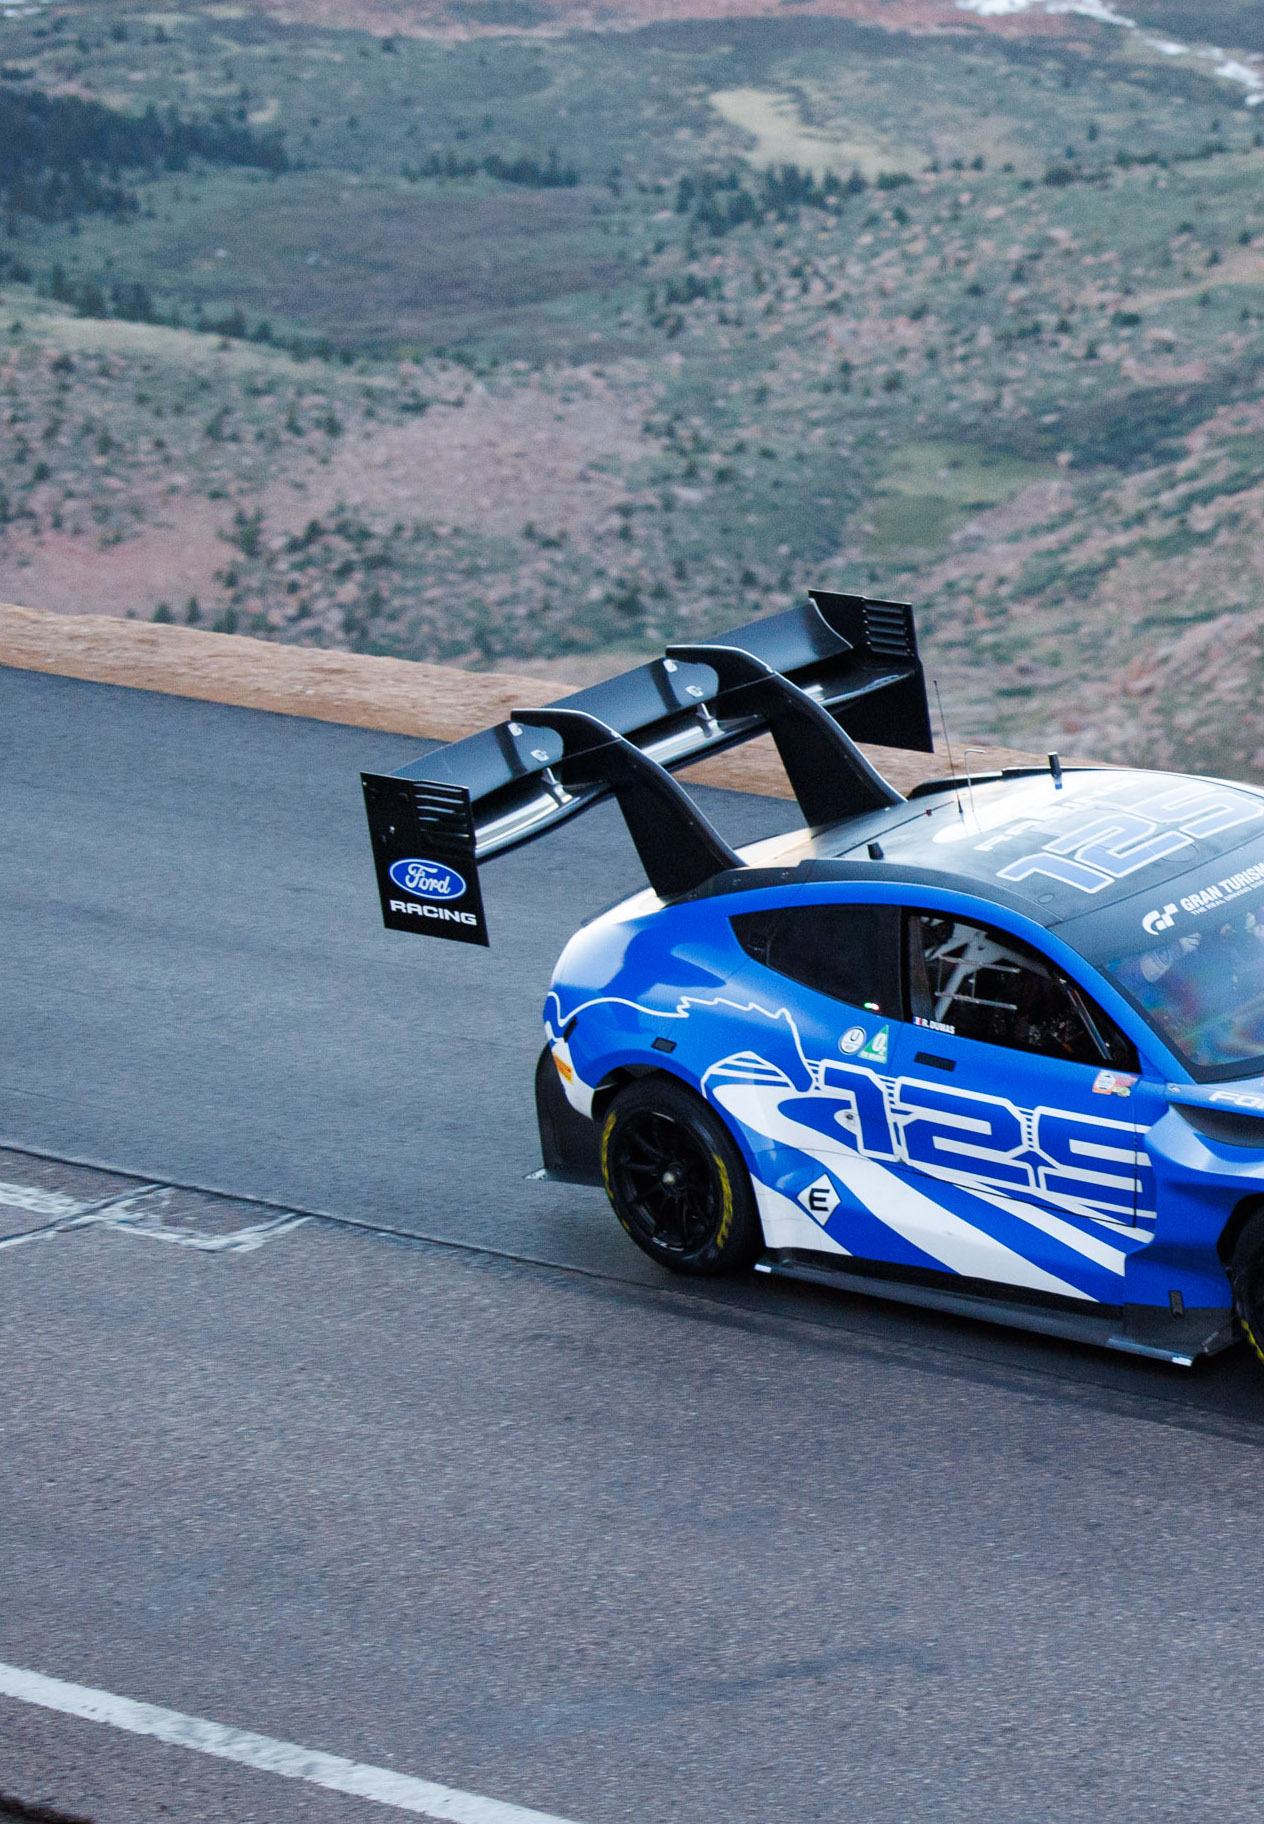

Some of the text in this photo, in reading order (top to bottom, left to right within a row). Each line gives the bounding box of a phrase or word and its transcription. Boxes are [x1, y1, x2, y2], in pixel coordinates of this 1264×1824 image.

[405, 863, 451, 894] Ford
[389, 899, 478, 926] RACING
[1179, 884, 1225, 913] GRAN
[808, 1187, 830, 1212] E
